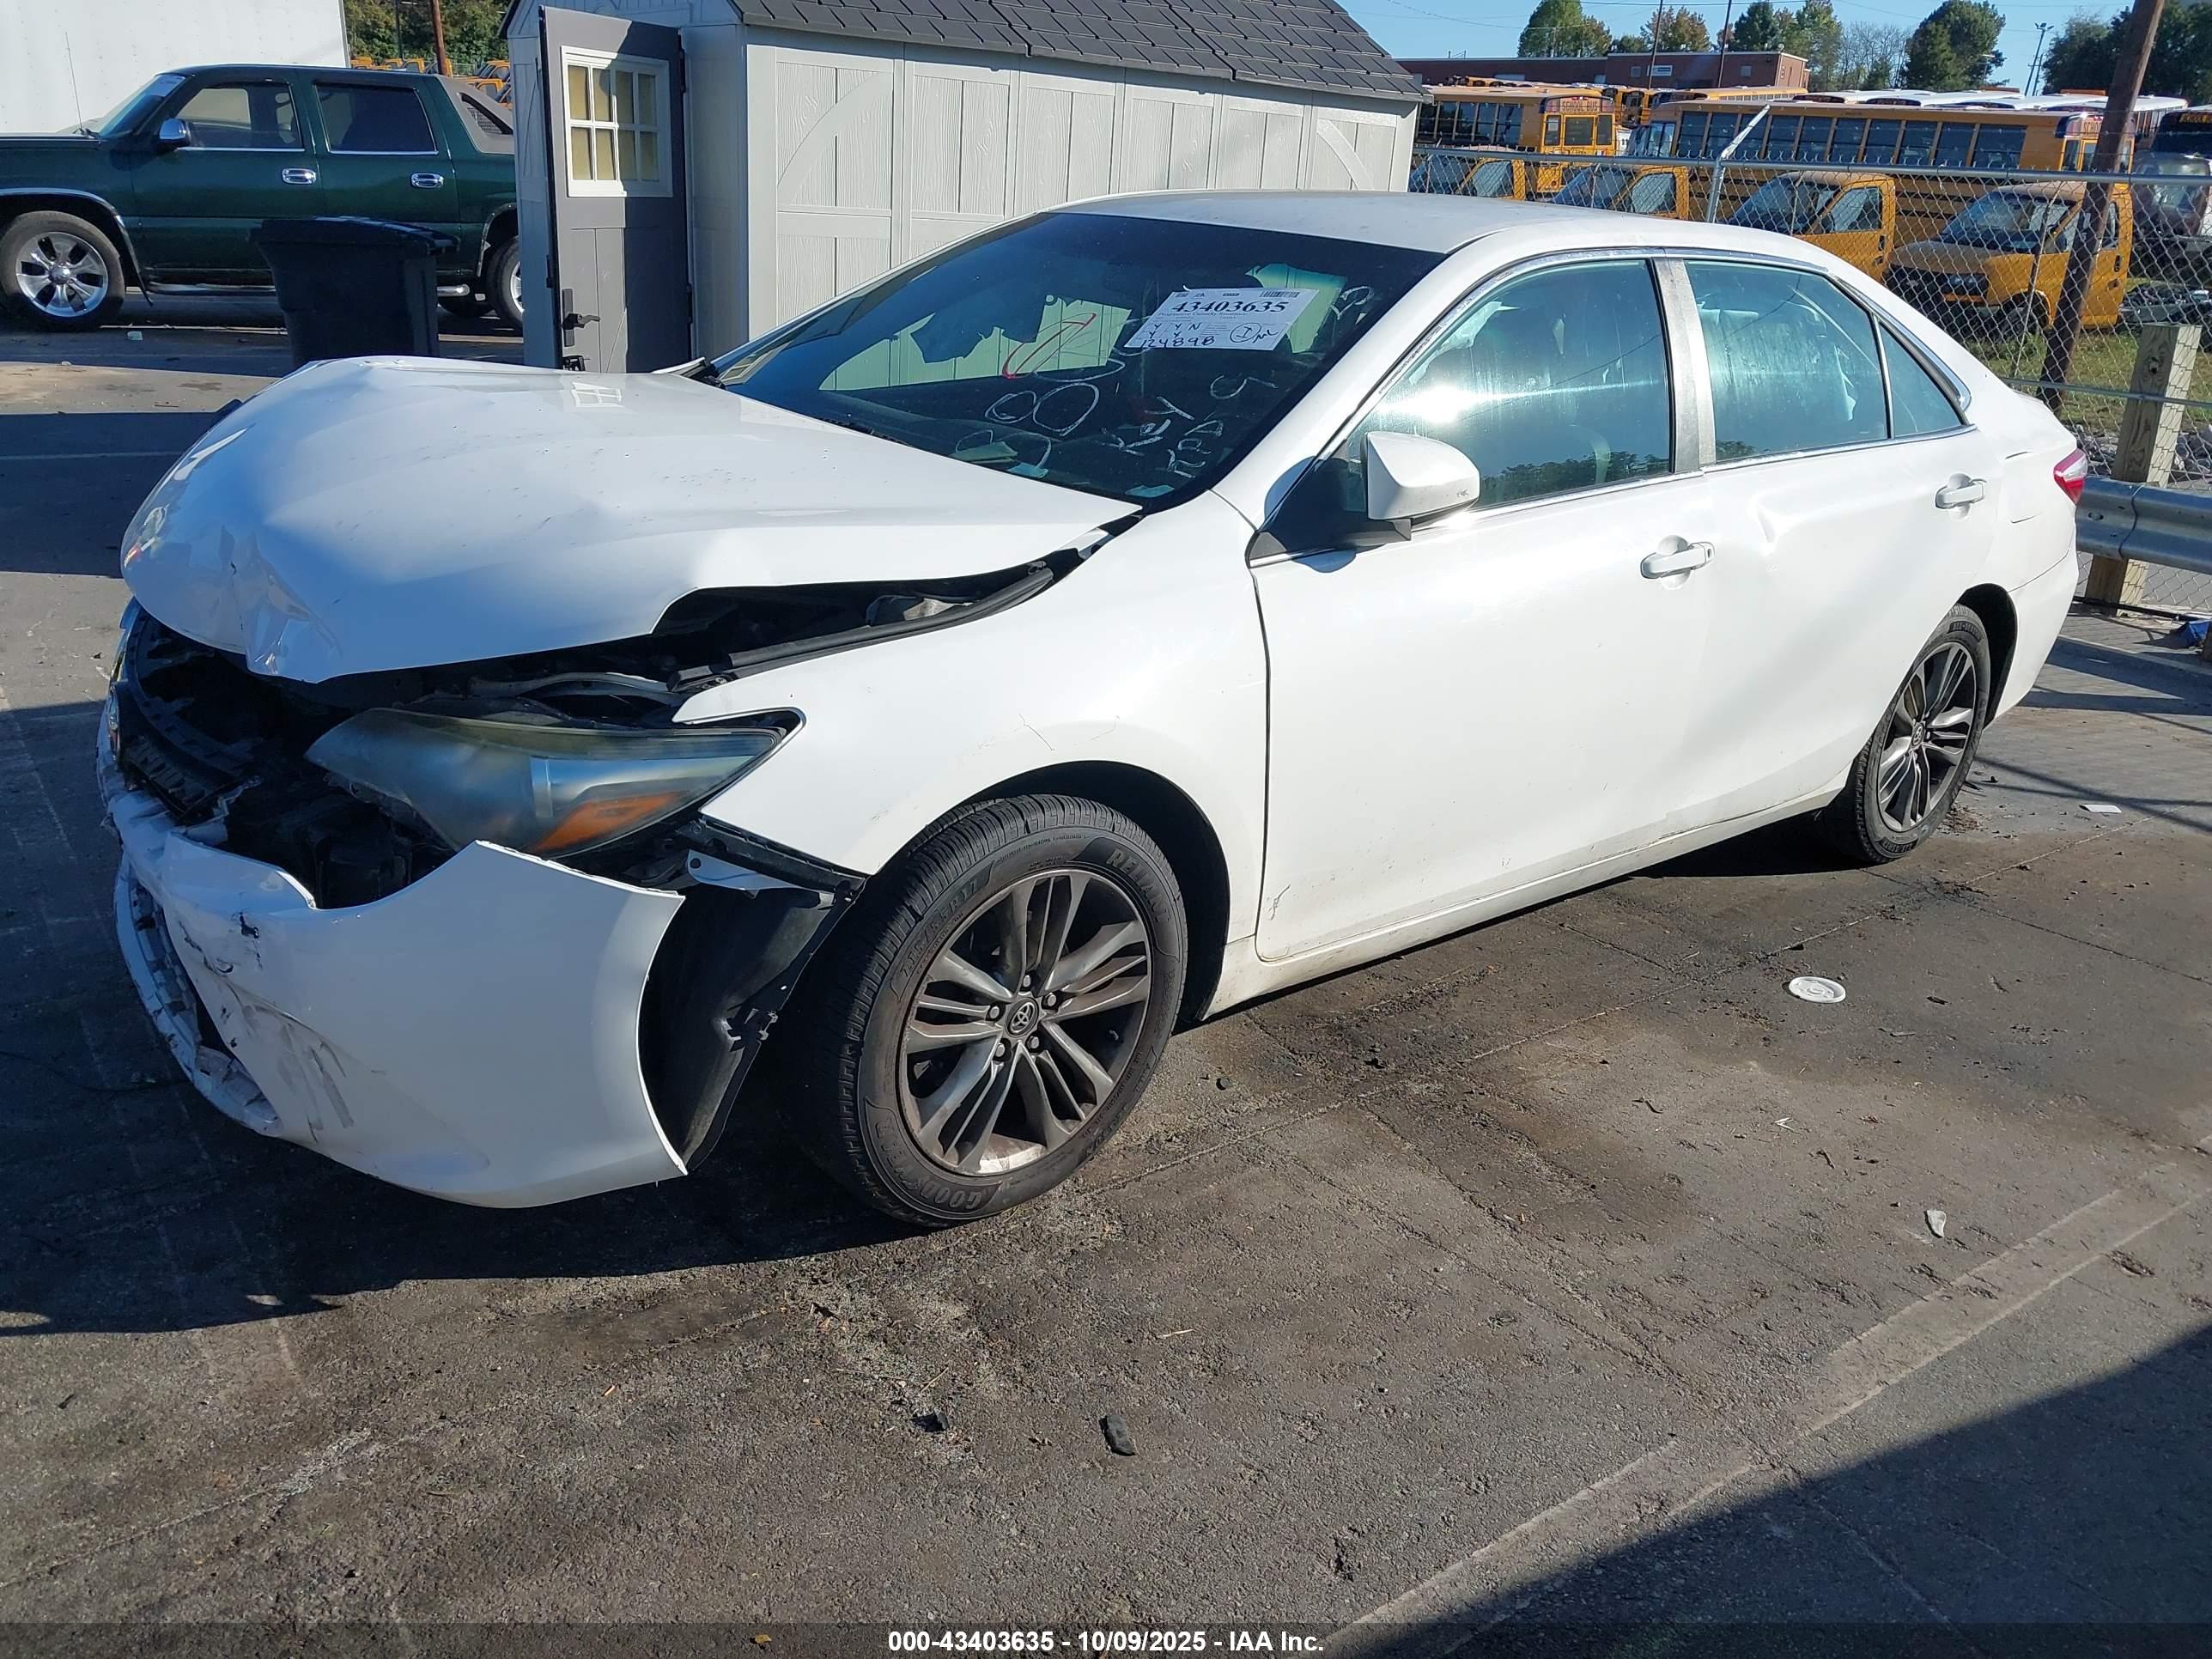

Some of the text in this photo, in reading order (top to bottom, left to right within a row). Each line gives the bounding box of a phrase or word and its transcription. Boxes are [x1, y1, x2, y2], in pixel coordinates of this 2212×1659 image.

[1562, 100, 1598, 112] SCHOOL BUS
[1172, 301, 1289, 313] 43403635
